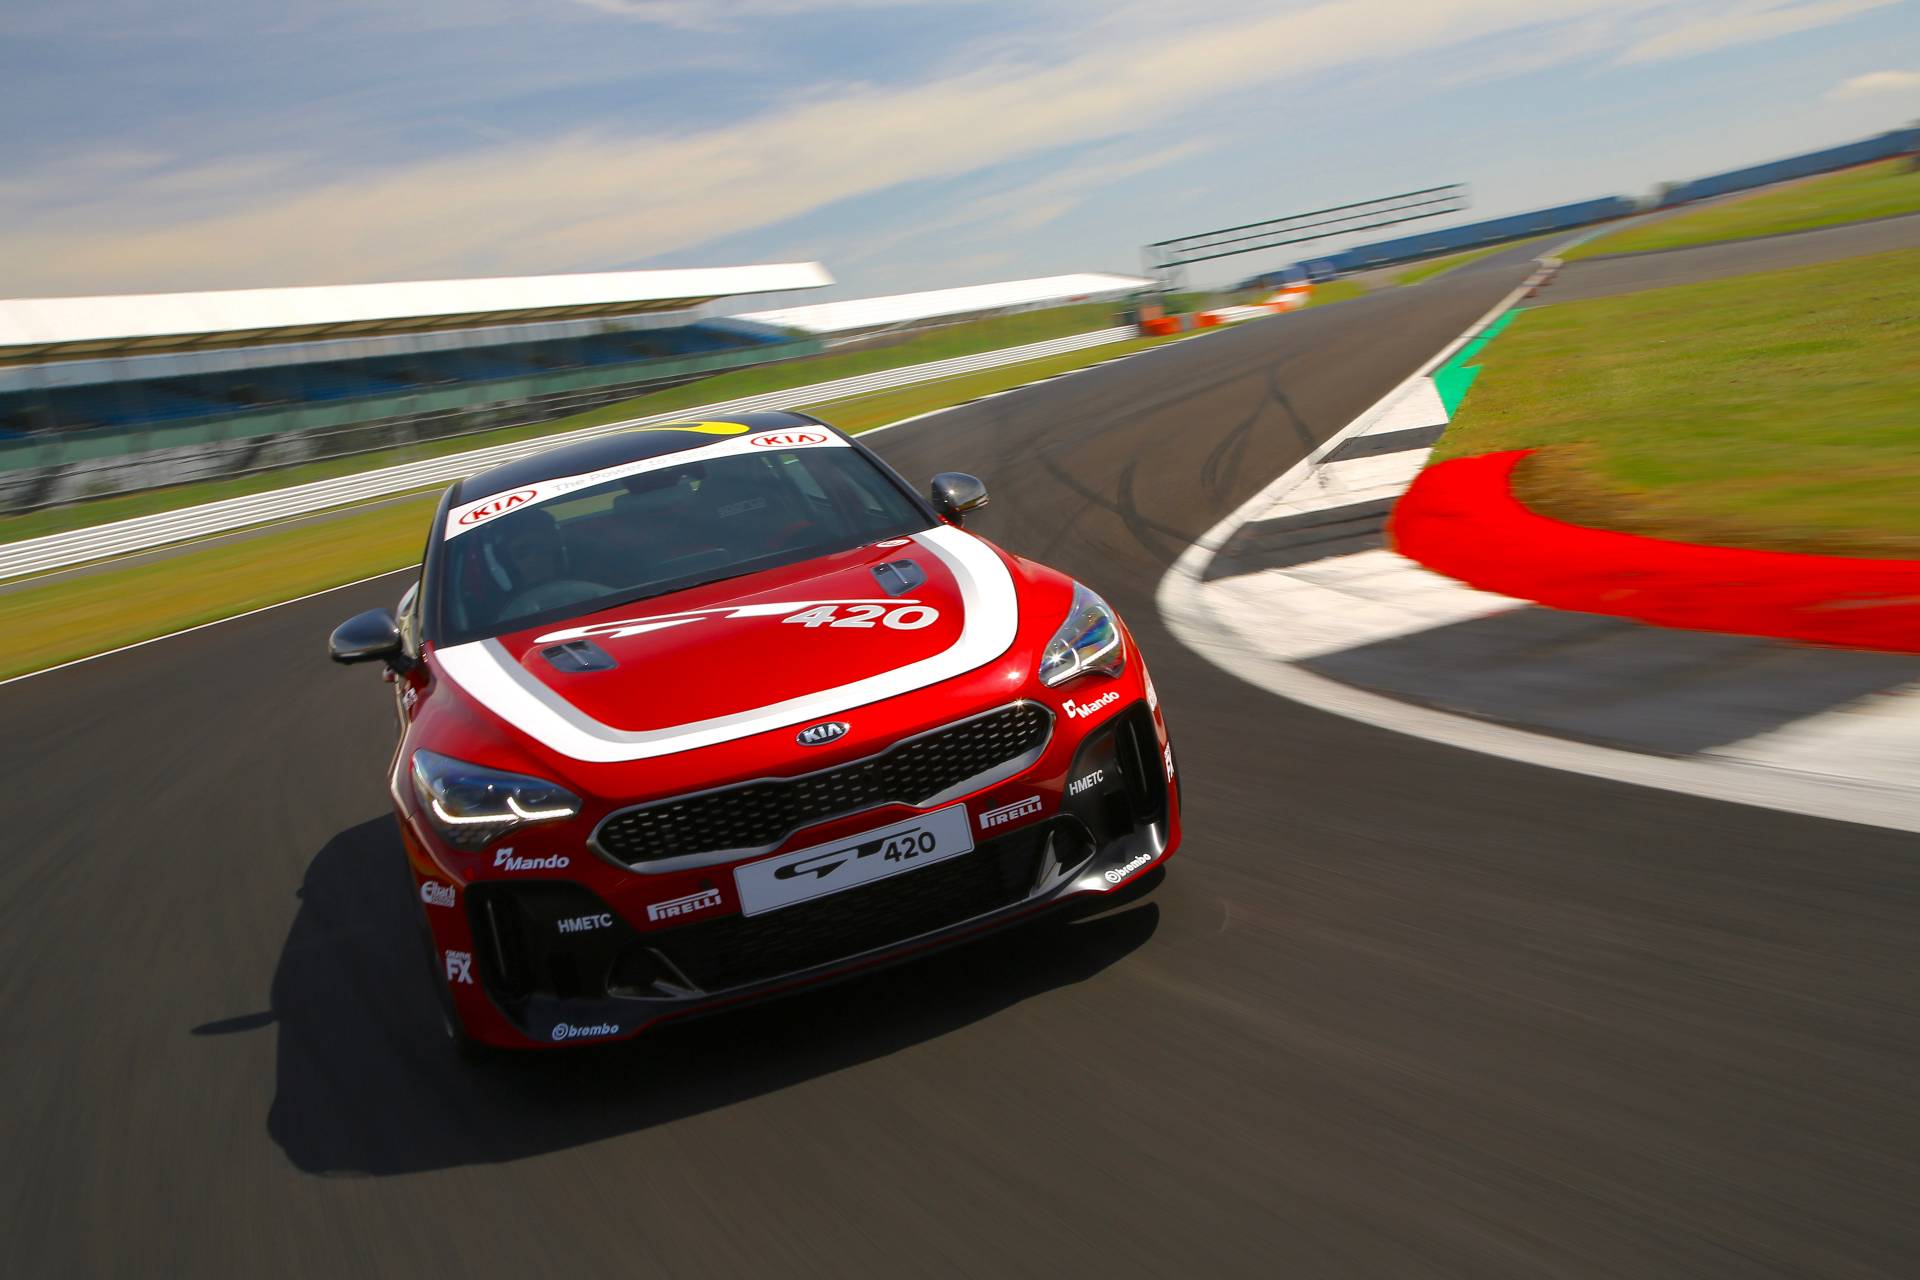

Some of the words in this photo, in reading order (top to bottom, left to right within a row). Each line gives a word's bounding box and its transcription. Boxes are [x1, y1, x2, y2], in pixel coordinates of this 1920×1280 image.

[762, 434, 816, 446] KIA
[470, 494, 526, 520] KIA
[781, 604, 940, 631] 420
[1075, 691, 1120, 718] Mando
[803, 722, 843, 743] KIA
[1069, 769, 1104, 796] HMETC
[978, 794, 1043, 830] PIRELLI
[883, 831, 936, 863] 420
[503, 853, 570, 872] Mando
[1114, 853, 1152, 877] brembo
[646, 887, 722, 922] PIRELLI
[557, 912, 614, 934] HMETC
[446, 957, 474, 985] FX
[568, 1022, 620, 1038] brembo
